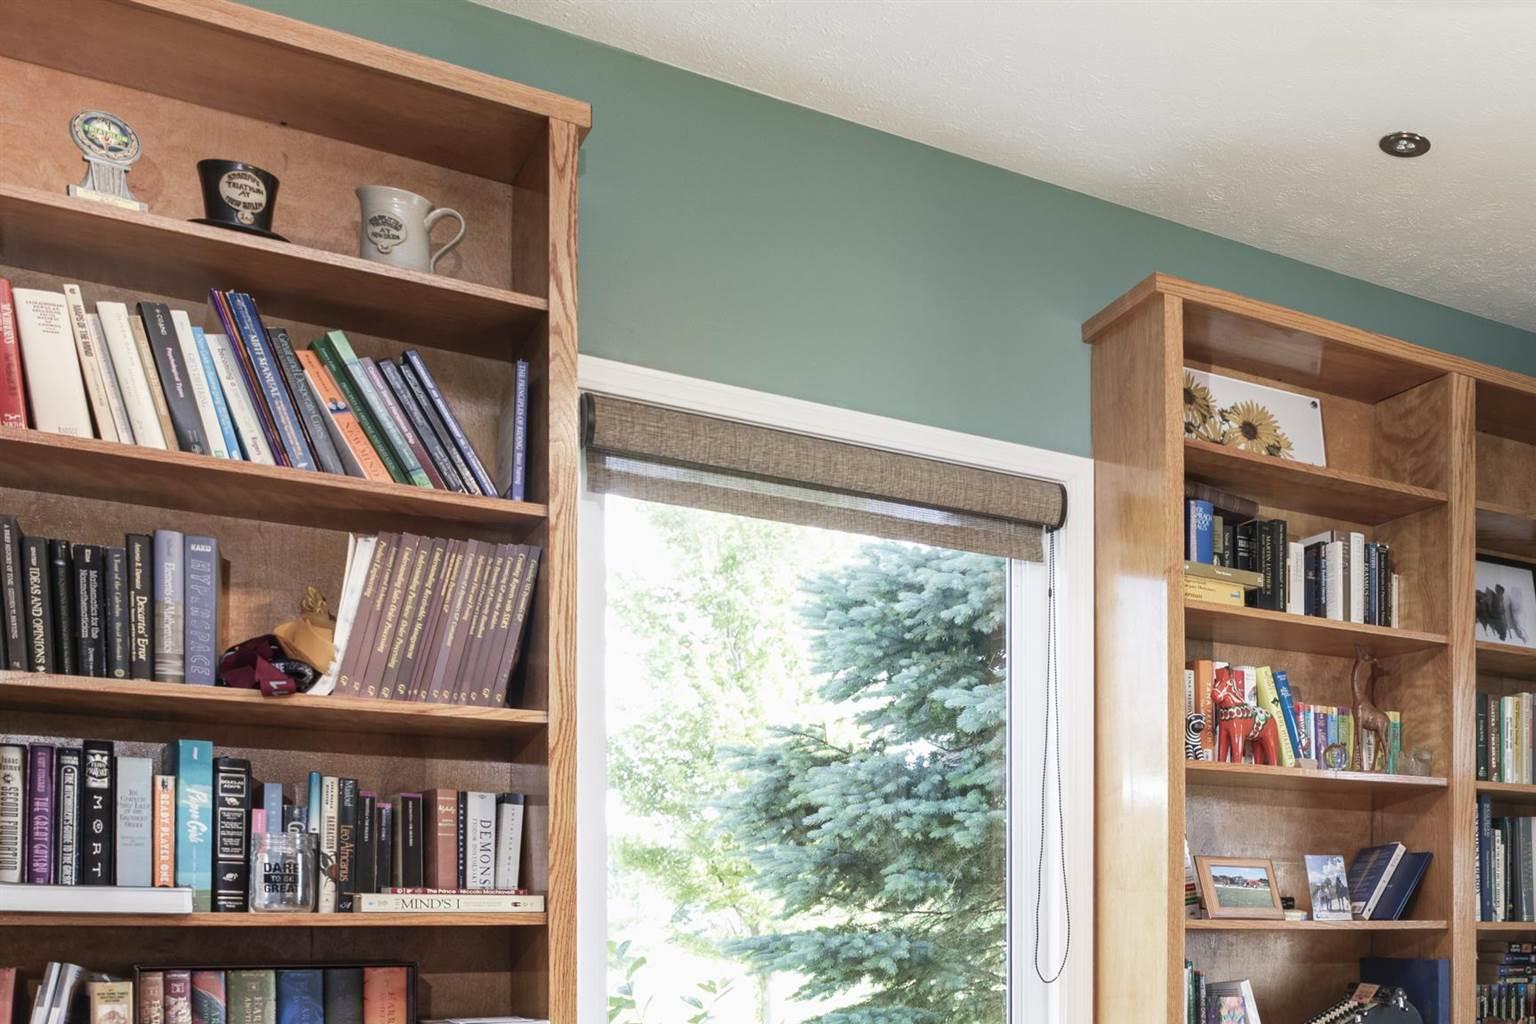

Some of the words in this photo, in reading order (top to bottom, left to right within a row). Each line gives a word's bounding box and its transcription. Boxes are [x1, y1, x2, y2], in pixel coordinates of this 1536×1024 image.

[29, 567, 40, 594] IDEAS
[163, 562, 176, 595] Elements
[364, 562, 379, 597] Engineering
[31, 595, 42, 616] AND
[32, 618, 45, 663] OPINIONS
[162, 606, 177, 654] Mathematics
[136, 638, 148, 660] Error
[0, 786, 17, 816] SECOND
[32, 797, 48, 811] THE
[159, 793, 170, 823] READY
[32, 815, 48, 841] GREAT
[92, 795, 104, 878] MORT
[339, 824, 354, 841] Leo
[0, 820, 17, 870] FOUNDATION
[32, 843, 48, 872] GATSBY
[157, 826, 169, 861] PLAYER
[476, 818, 492, 885] DEMONS
[157, 863, 168, 882] ONE
[338, 841, 353, 881] Africanus
[401, 899, 452, 909] MIND'S
